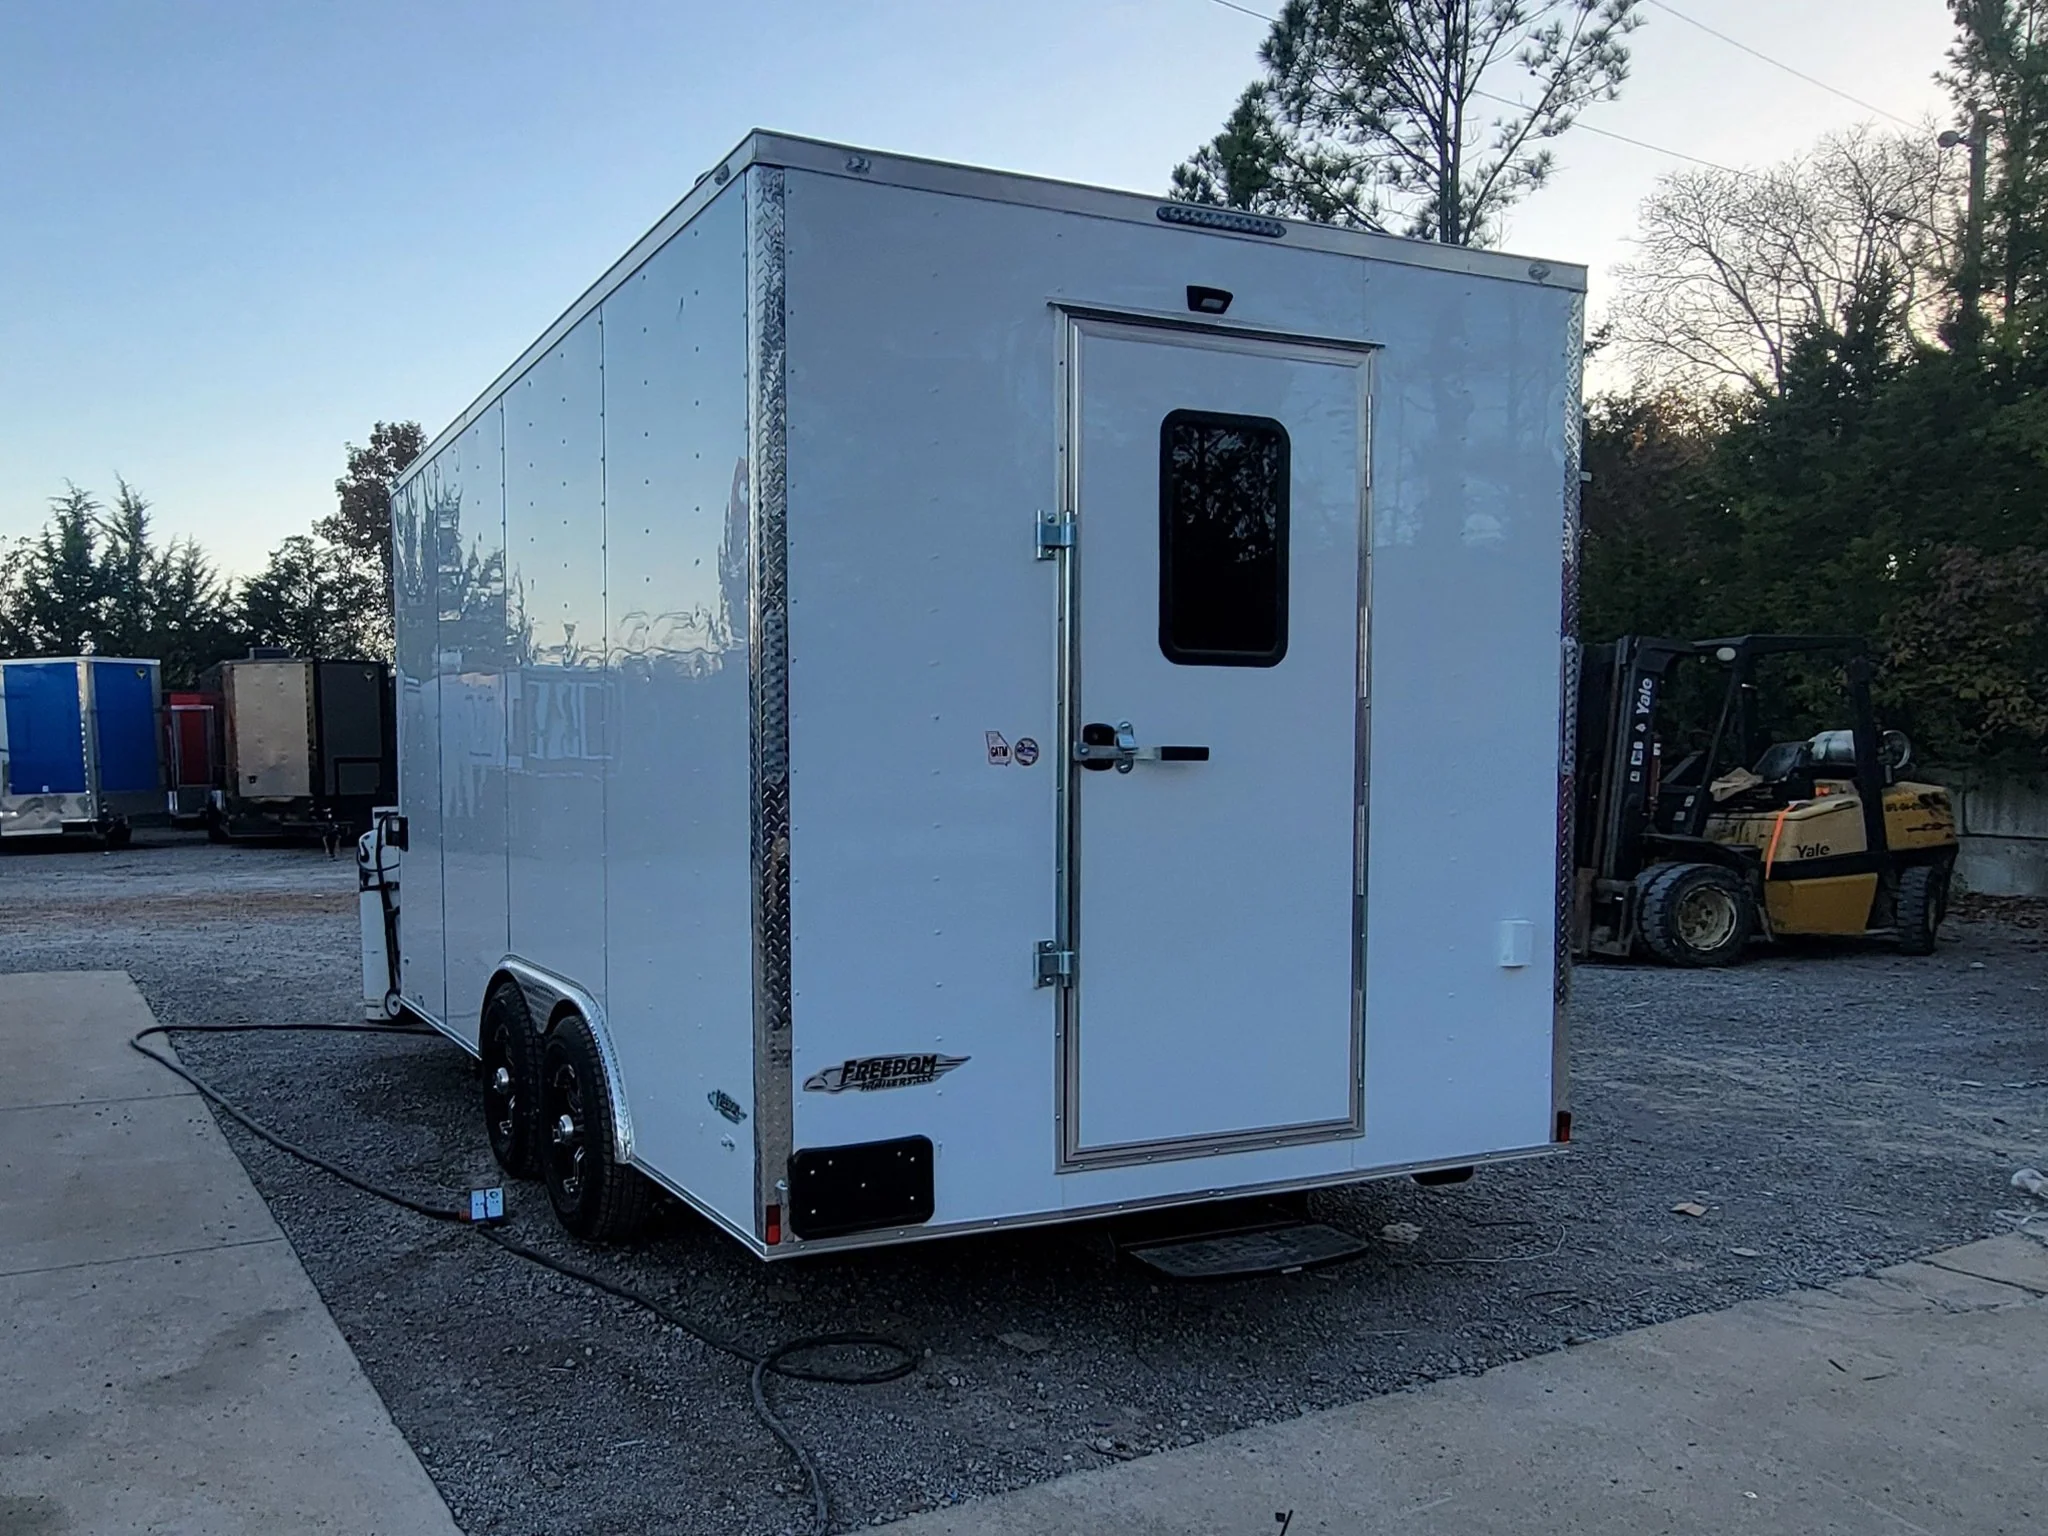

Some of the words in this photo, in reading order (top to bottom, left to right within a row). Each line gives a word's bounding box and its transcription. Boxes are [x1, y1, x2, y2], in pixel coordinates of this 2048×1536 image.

[1636, 678, 1653, 714] Yale
[1795, 843, 1830, 858] Yale
[840, 1054, 937, 1086] FREEDOM
